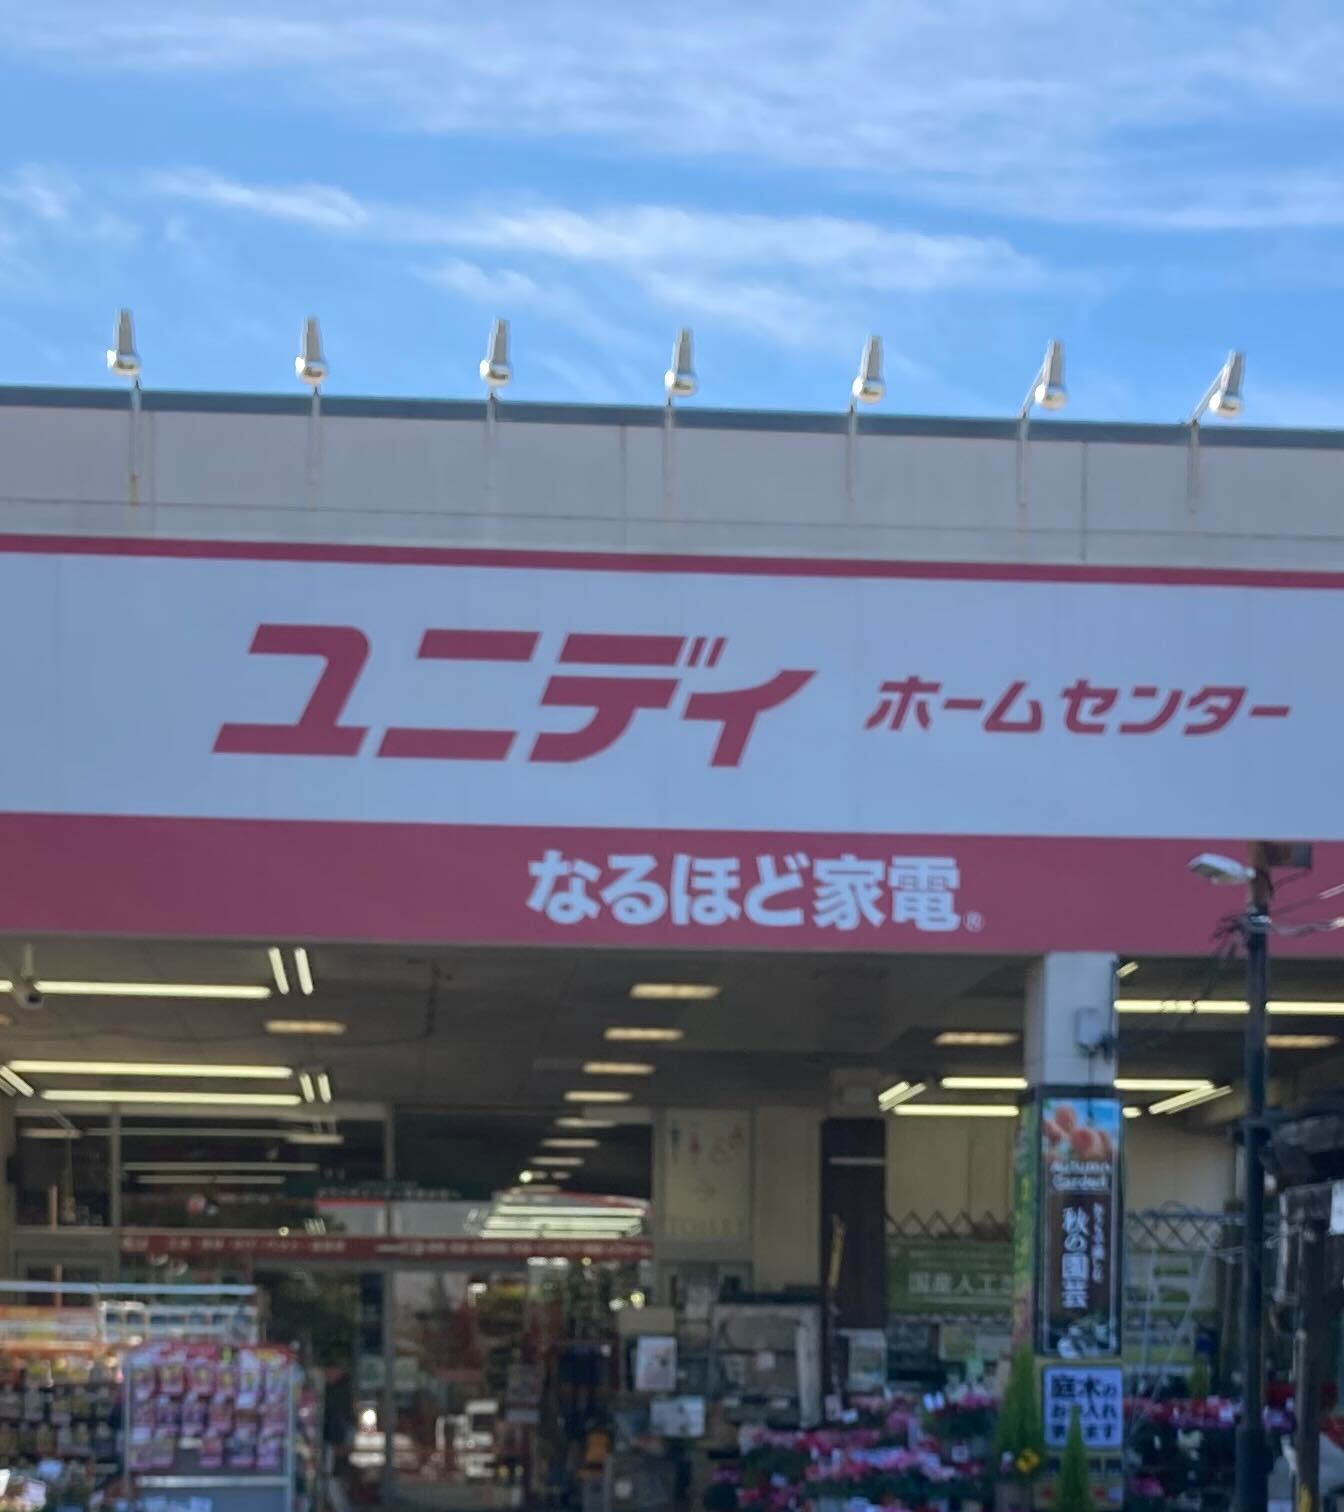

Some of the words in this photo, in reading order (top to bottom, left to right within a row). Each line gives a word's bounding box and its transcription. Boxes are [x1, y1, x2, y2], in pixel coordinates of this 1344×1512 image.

[212, 623, 819, 767] ユニディ
[863, 676, 1291, 736] ホームセンター
